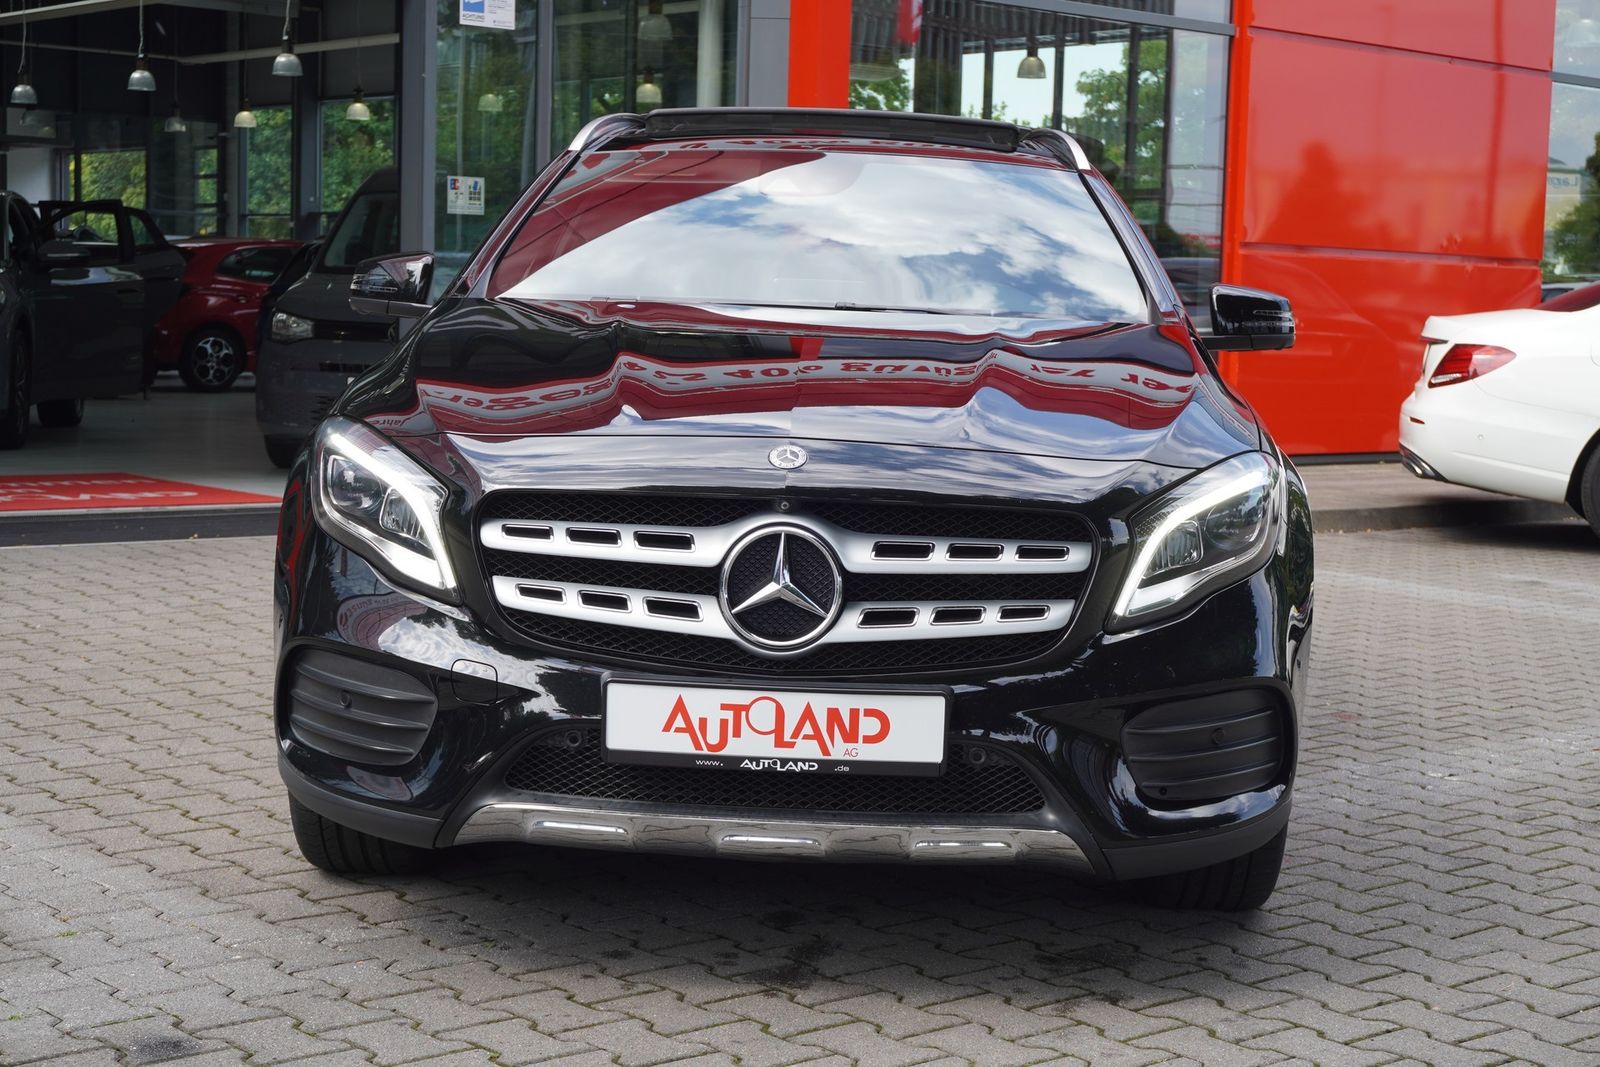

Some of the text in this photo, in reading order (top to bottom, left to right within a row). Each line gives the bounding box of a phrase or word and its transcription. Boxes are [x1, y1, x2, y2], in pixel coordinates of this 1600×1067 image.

[842, 747, 860, 759] AG
[695, 759, 724, 767] www.
[834, 764, 851, 773] .de
